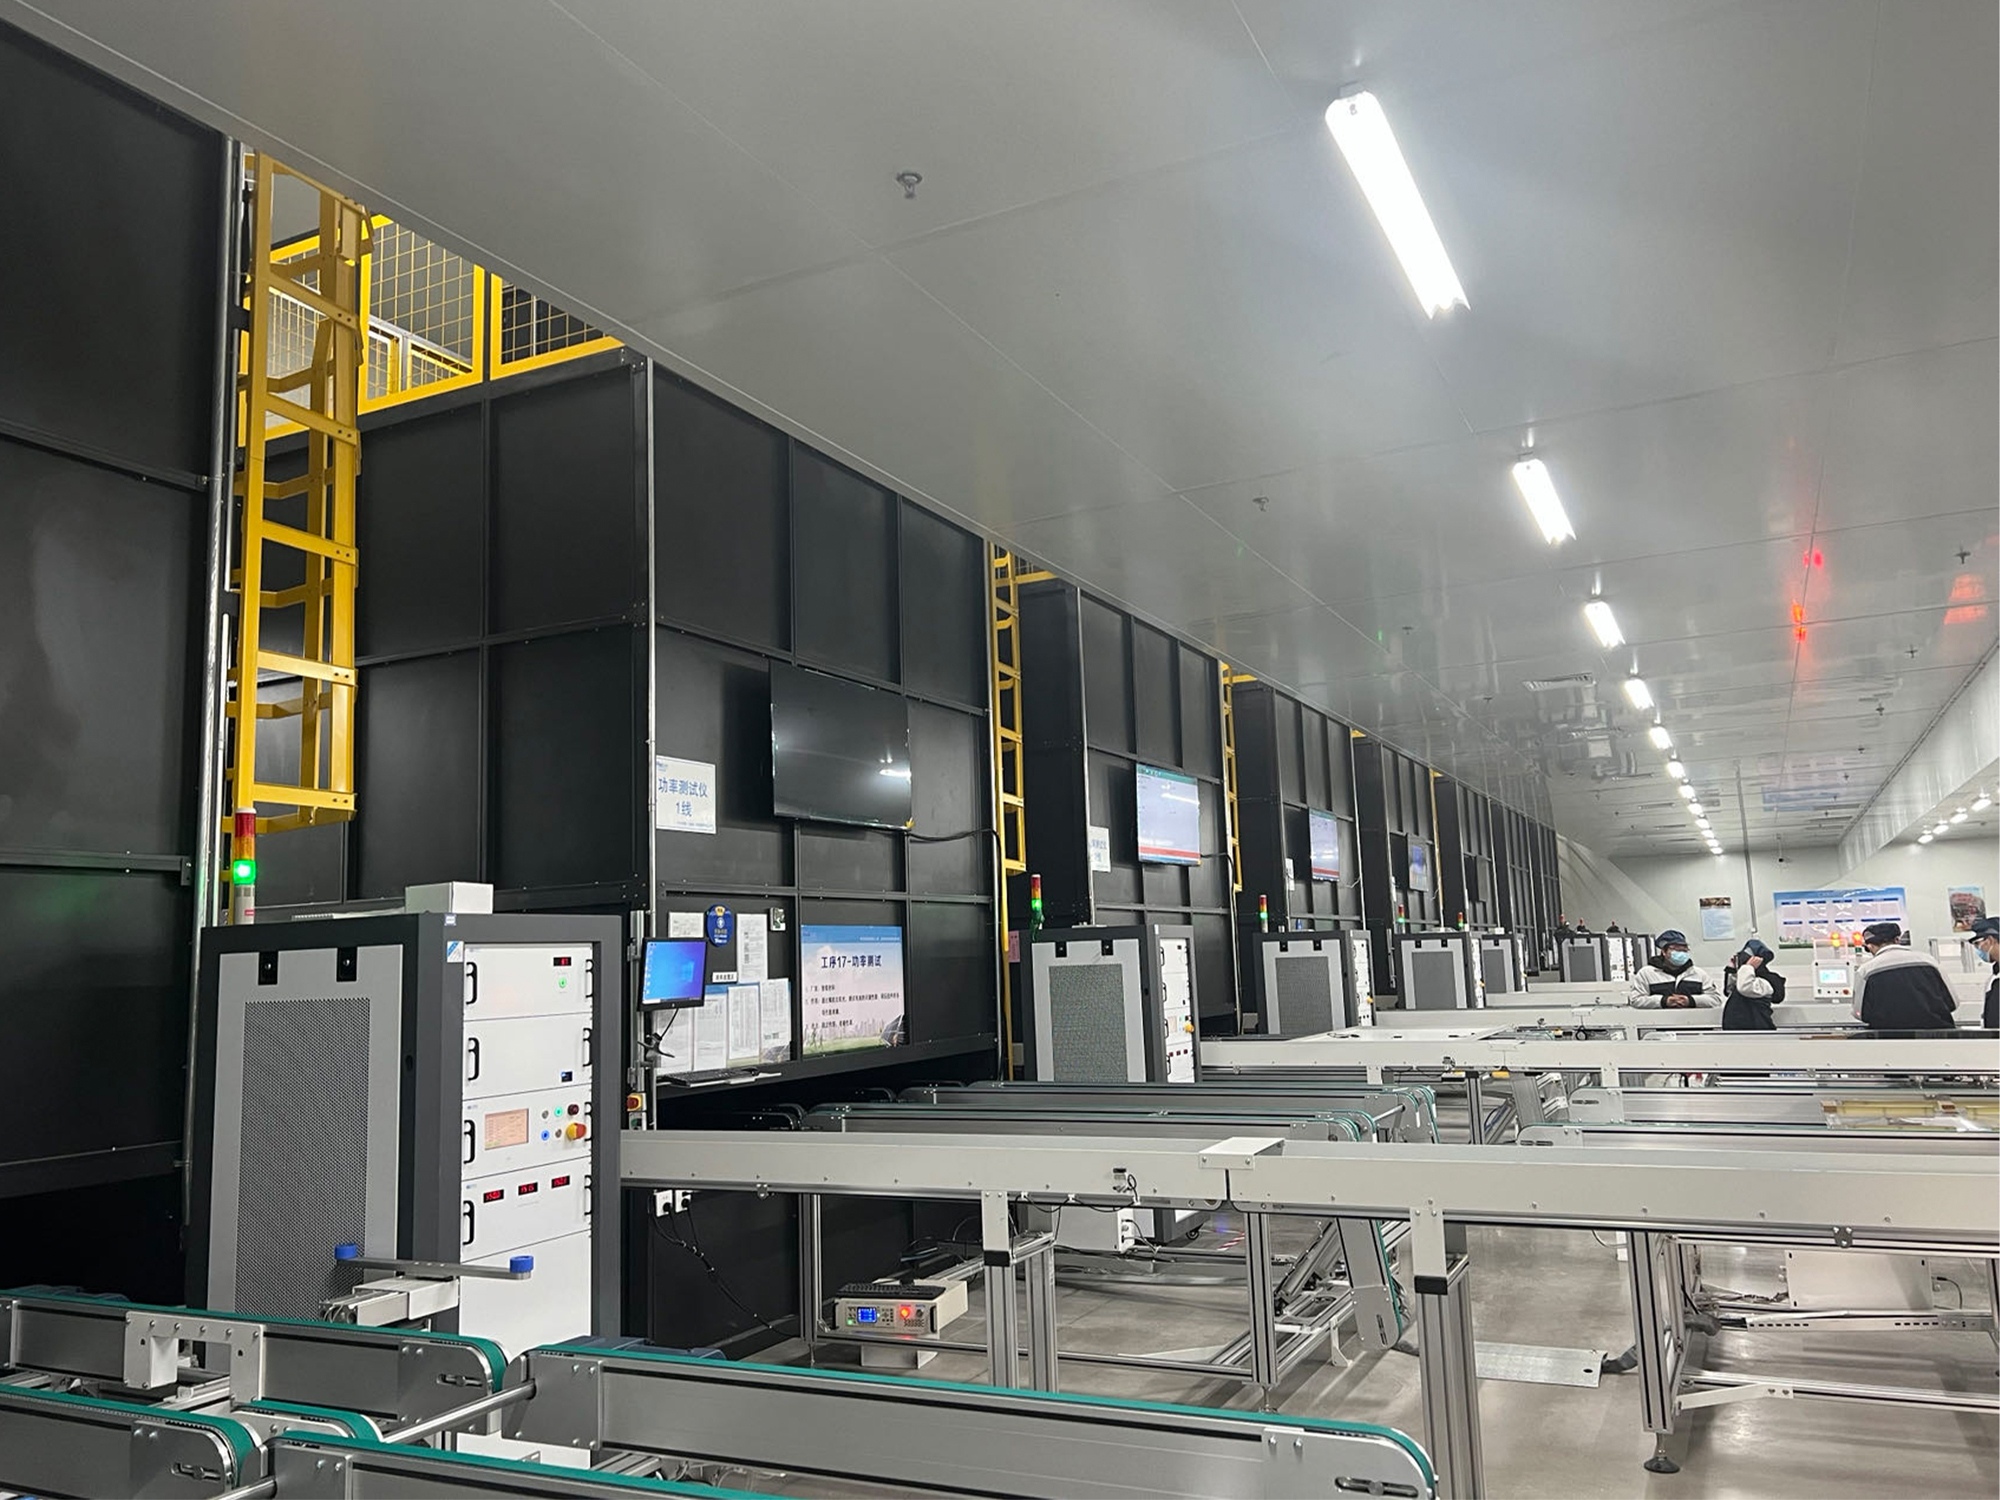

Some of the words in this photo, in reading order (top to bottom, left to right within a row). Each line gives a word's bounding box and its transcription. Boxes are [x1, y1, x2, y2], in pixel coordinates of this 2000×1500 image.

[658, 777, 708, 797] 功率测试仪
[675, 800, 692, 817] 1线
[821, 955, 882, 969] 工序17-功率测试
